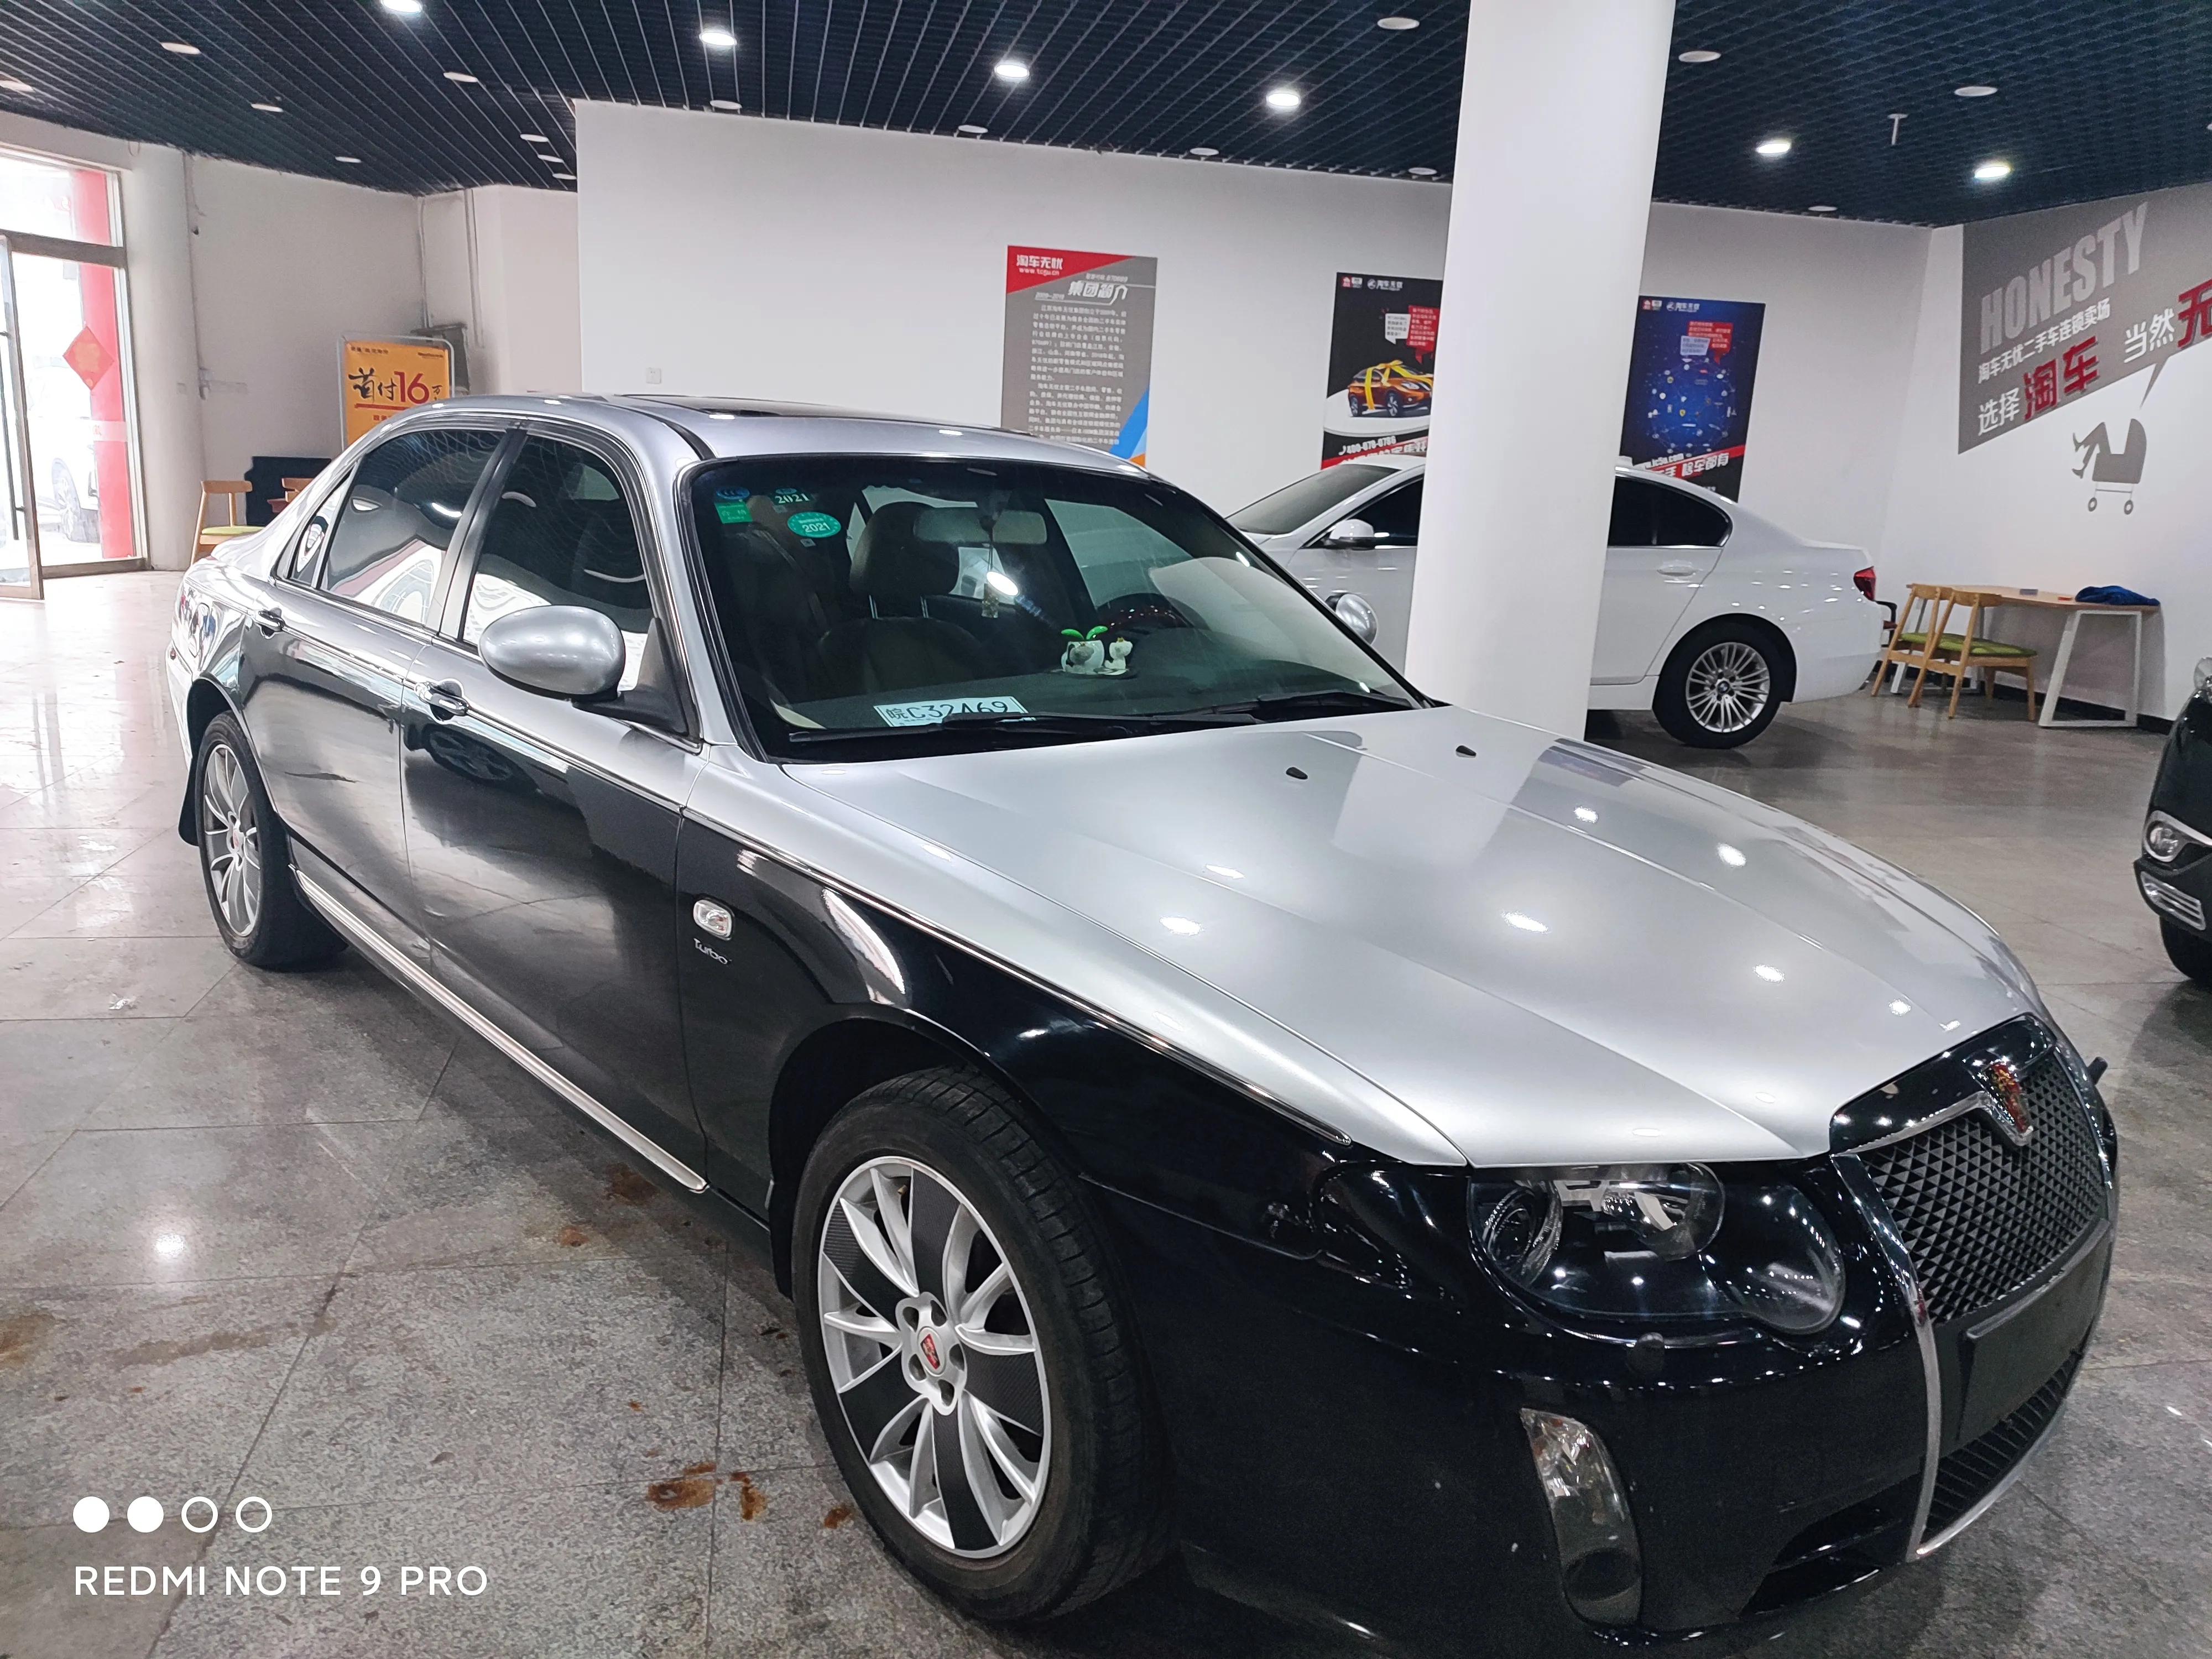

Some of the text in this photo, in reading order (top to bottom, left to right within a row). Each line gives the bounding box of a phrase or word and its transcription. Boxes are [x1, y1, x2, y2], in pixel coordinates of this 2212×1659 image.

[1980, 202, 2148, 354] HONESTY
[775, 493, 810, 504] 2021
[802, 522, 831, 533] 2021
